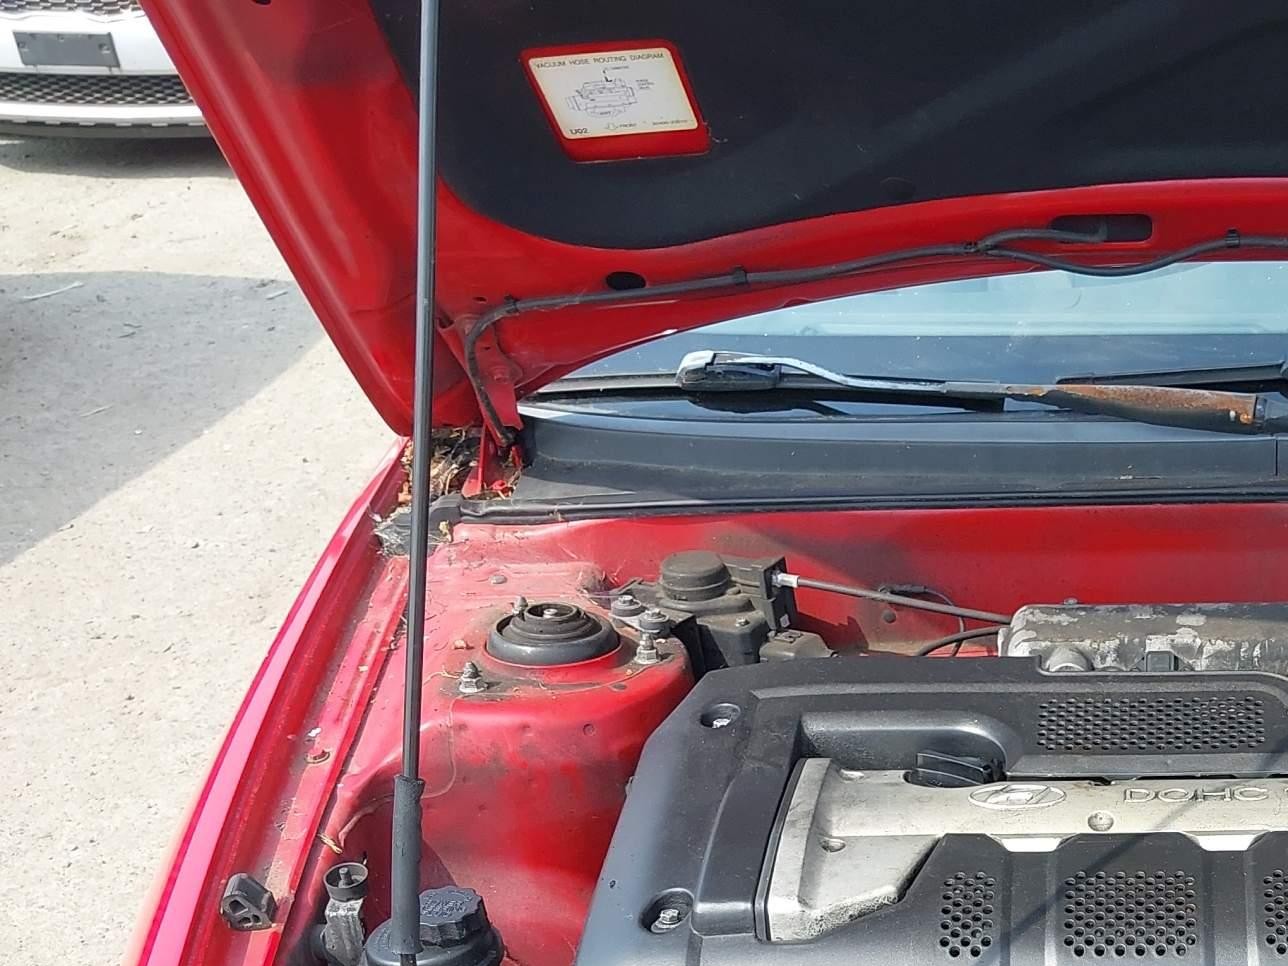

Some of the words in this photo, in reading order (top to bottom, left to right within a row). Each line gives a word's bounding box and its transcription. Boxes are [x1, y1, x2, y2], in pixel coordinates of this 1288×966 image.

[535, 61, 566, 69] VACUUM
[593, 55, 627, 64] ROUTING
[630, 52, 665, 61] DIAGRAM
[1123, 786, 1269, 803] DOHC
